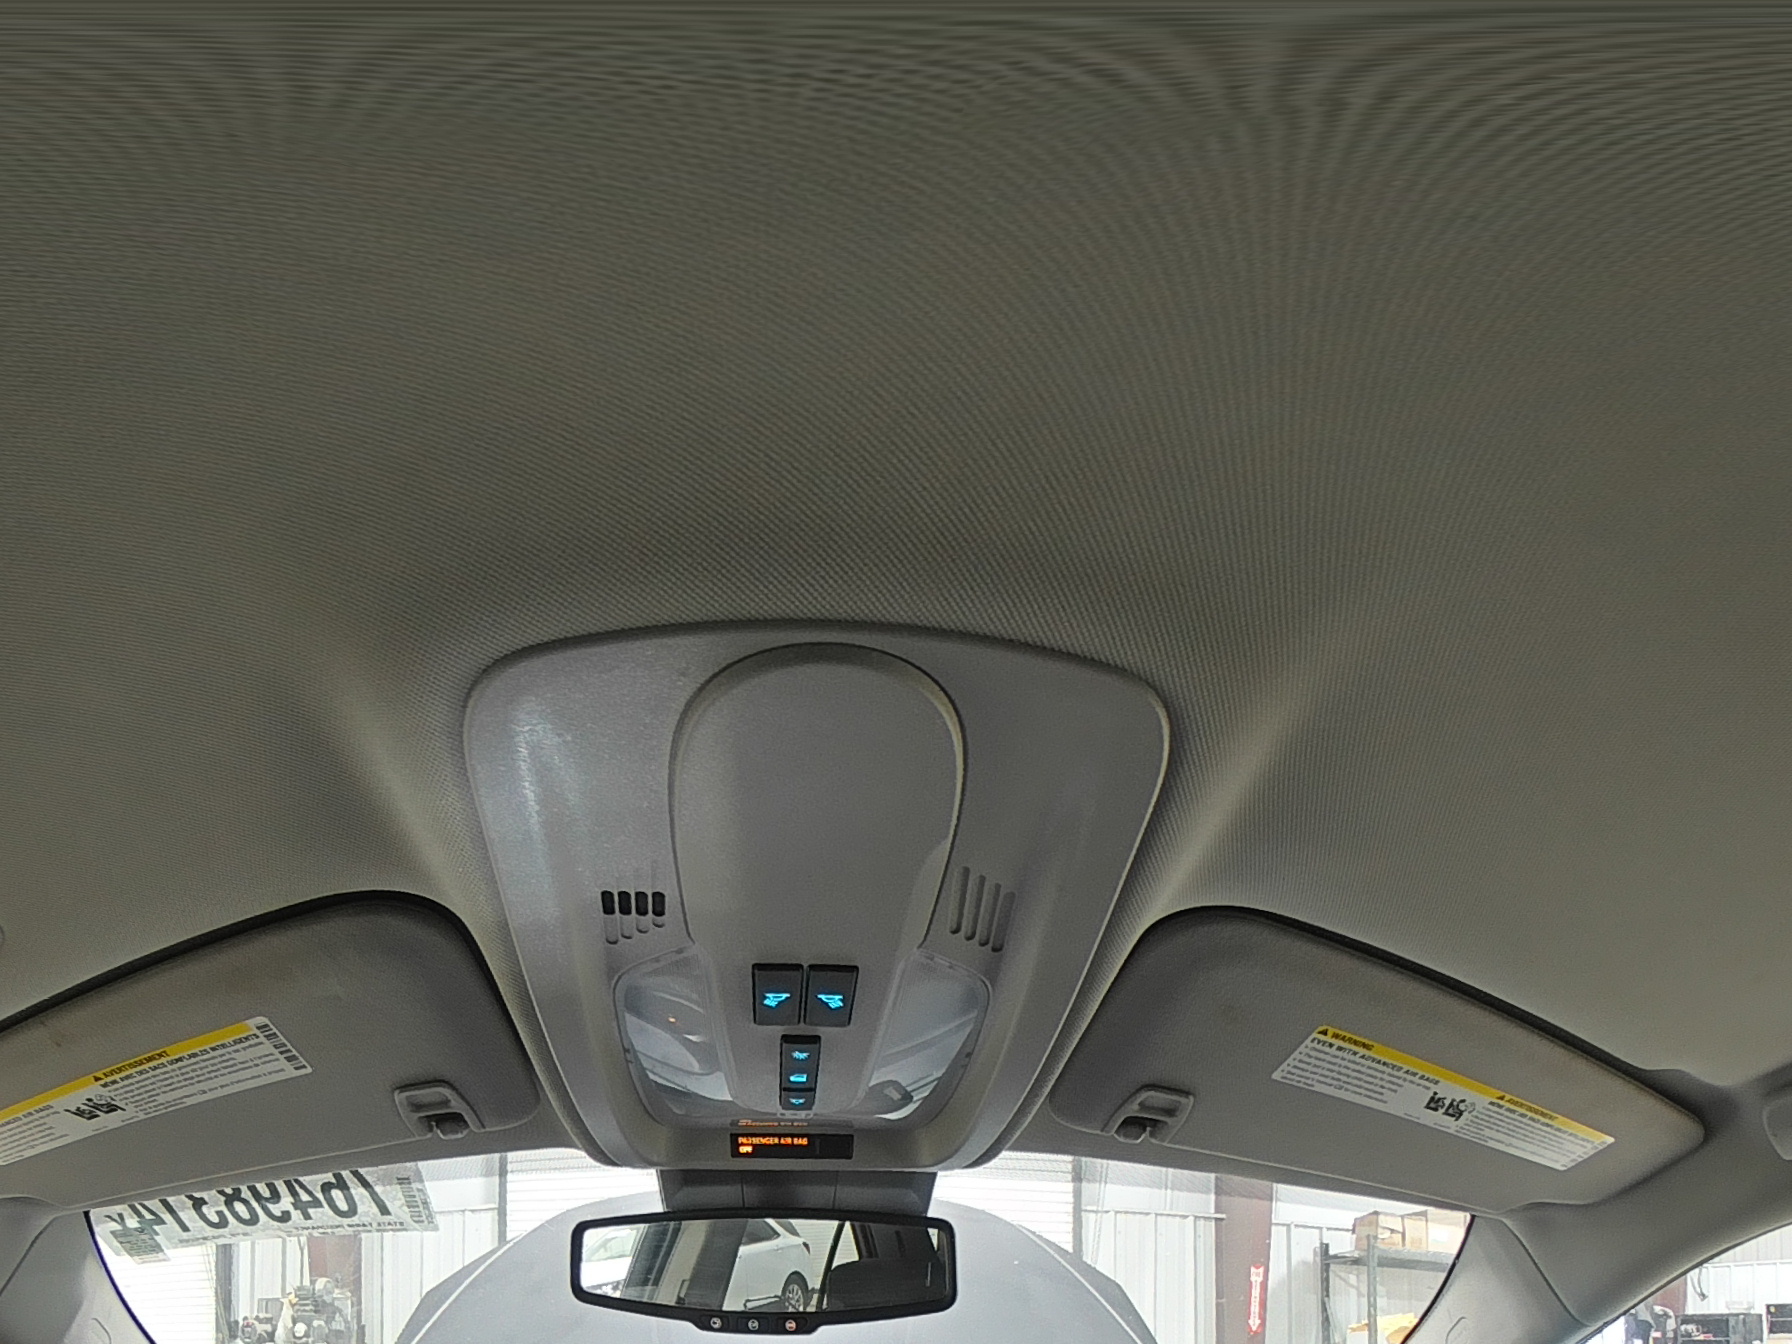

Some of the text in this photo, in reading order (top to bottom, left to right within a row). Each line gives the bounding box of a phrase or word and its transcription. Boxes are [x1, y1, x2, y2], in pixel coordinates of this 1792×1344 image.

[1331, 1032, 1375, 1051] WARNING
[738, 1136, 808, 1146] PASSENGER AIR BAG
